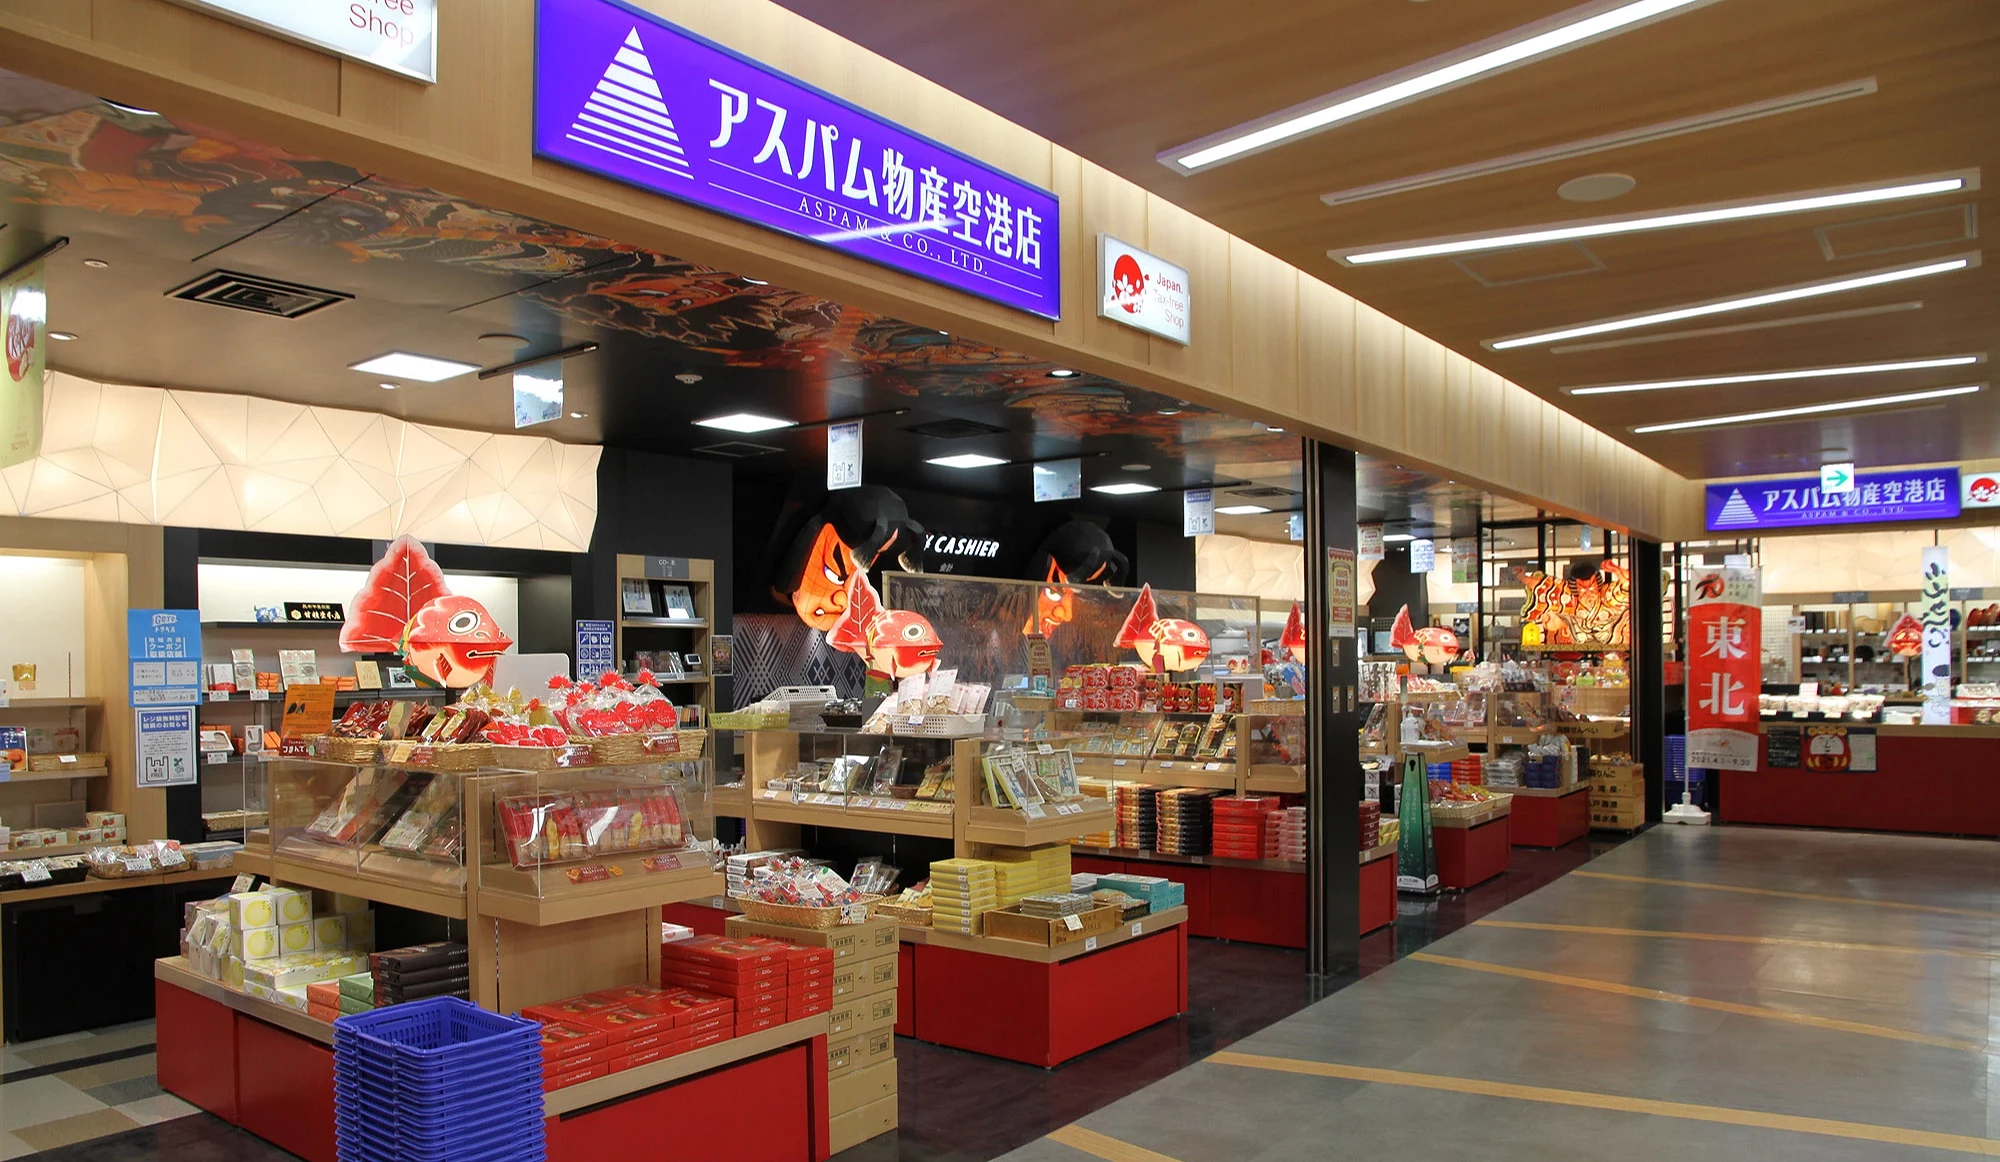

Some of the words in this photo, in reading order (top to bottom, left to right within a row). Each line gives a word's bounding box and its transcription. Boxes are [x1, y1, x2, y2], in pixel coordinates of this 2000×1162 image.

[350, 3, 414, 48] Shop
[709, 77, 1042, 270] アスパム物産空港店
[798, 196, 869, 232] ASPAM
[880, 229, 892, 242] &
[903, 233, 942, 260] CO.,
[950, 250, 988, 275] LTD.
[1156, 272, 1184, 294] Japan.
[1165, 309, 1184, 330] Shop
[1762, 477, 1946, 511] アスパム物産空港店
[934, 535, 1000, 558] CASHIER
[1699, 616, 1747, 715] 東北
